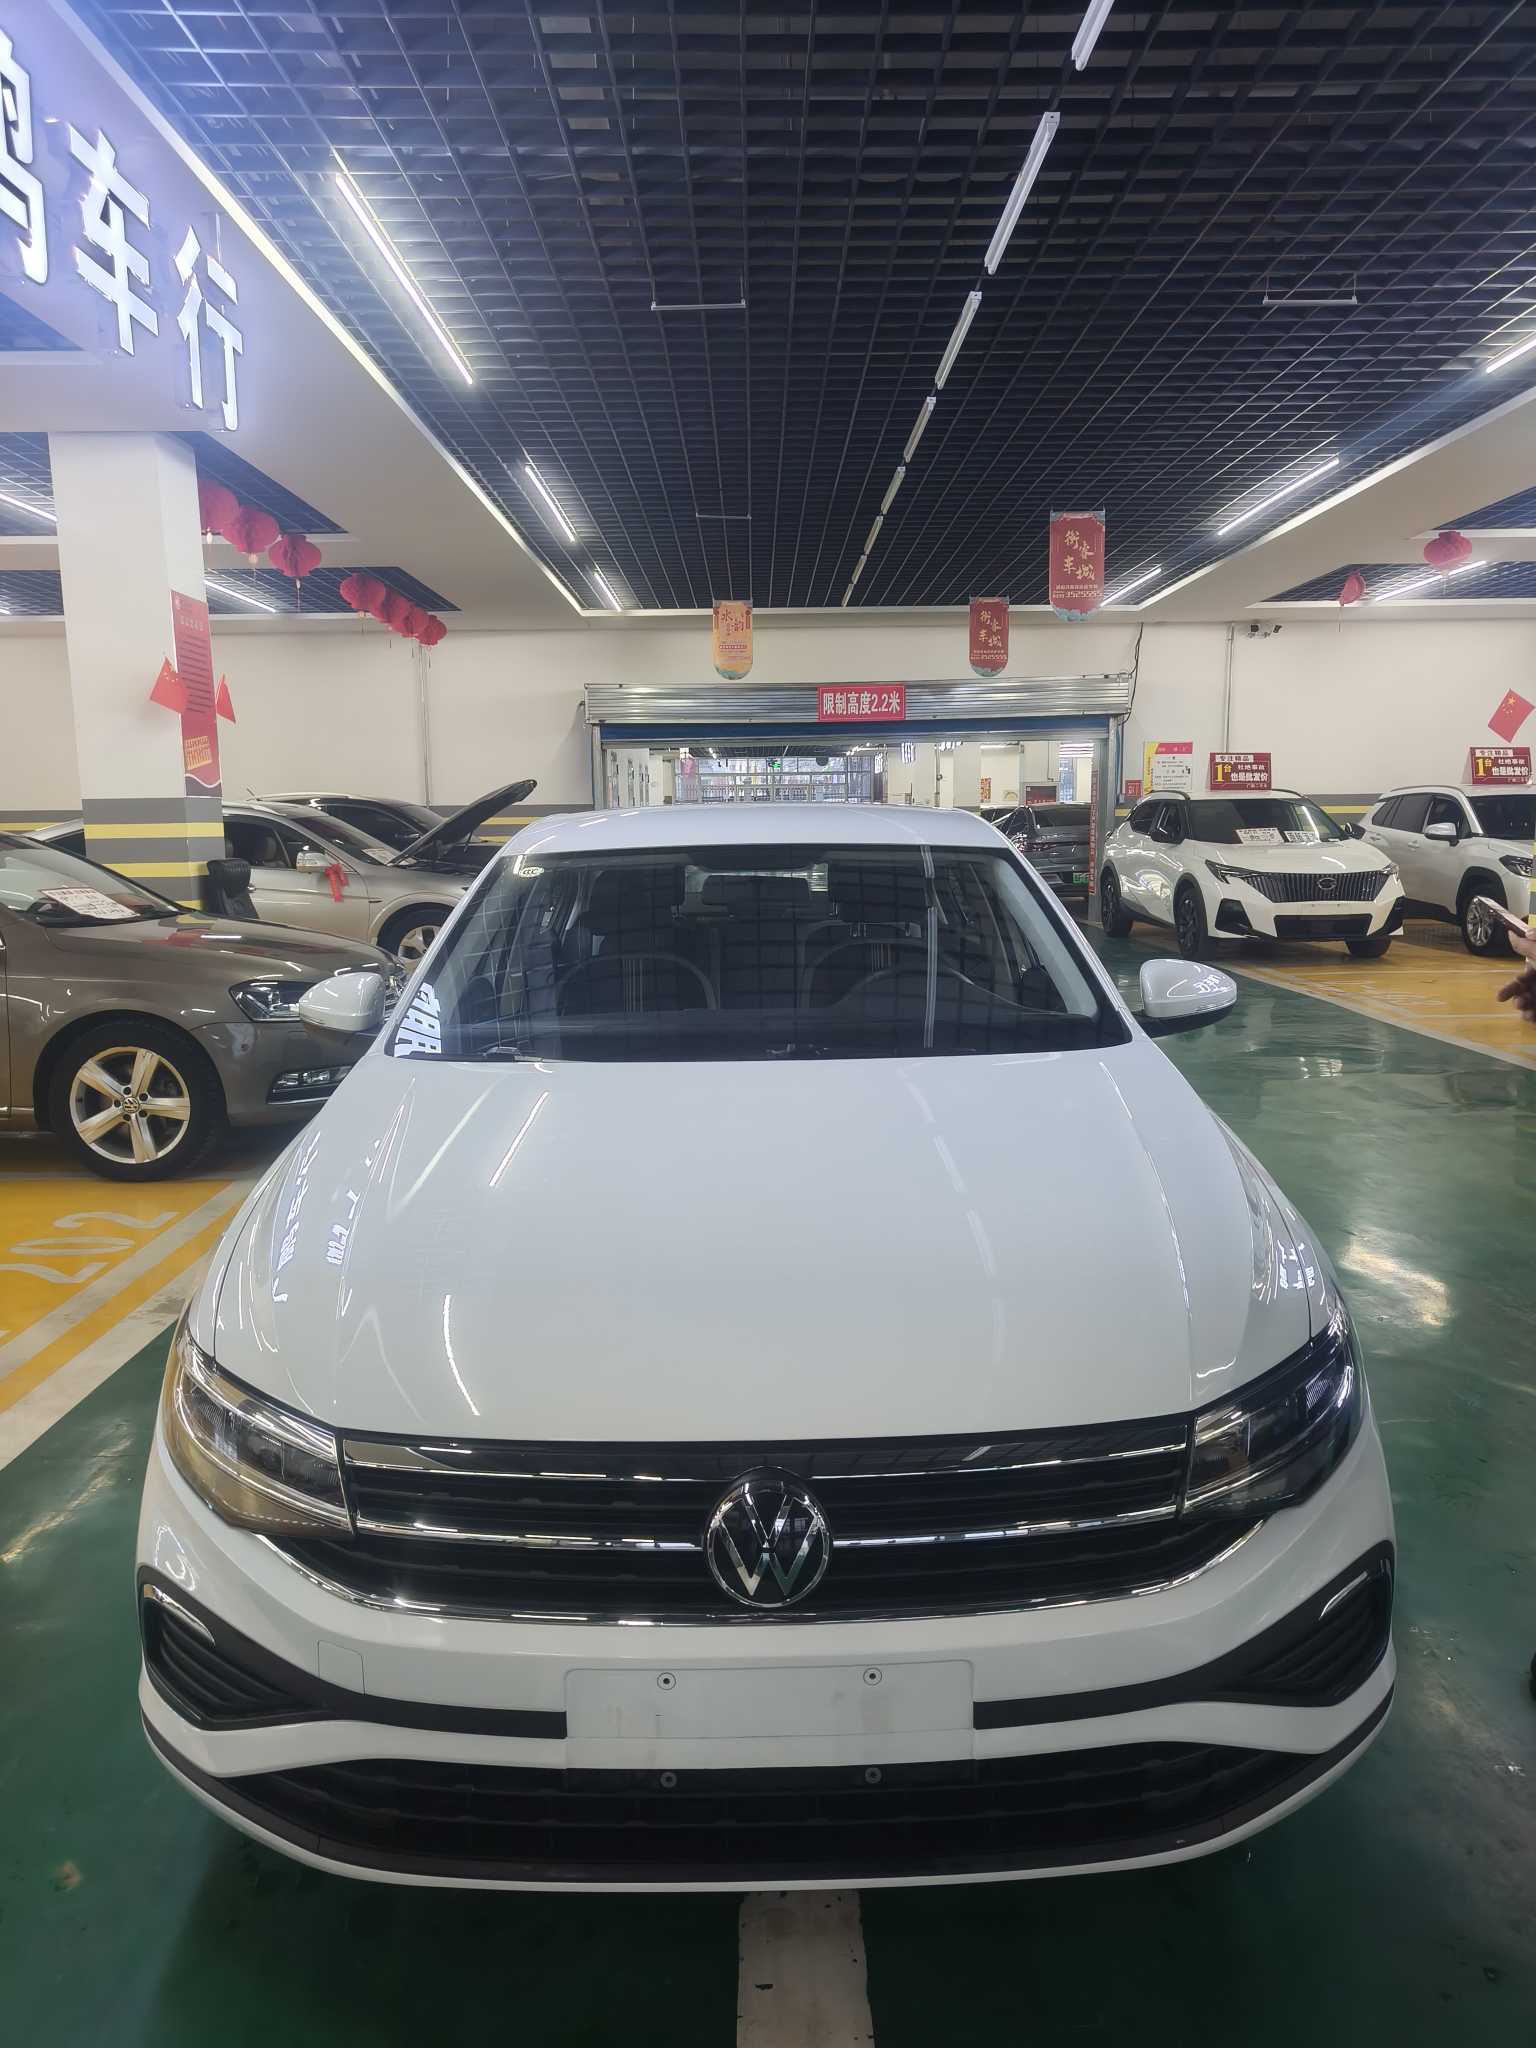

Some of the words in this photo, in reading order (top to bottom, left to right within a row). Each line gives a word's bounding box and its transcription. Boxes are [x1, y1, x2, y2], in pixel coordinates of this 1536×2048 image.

[823, 690, 900, 715] 限制高度2.2米
